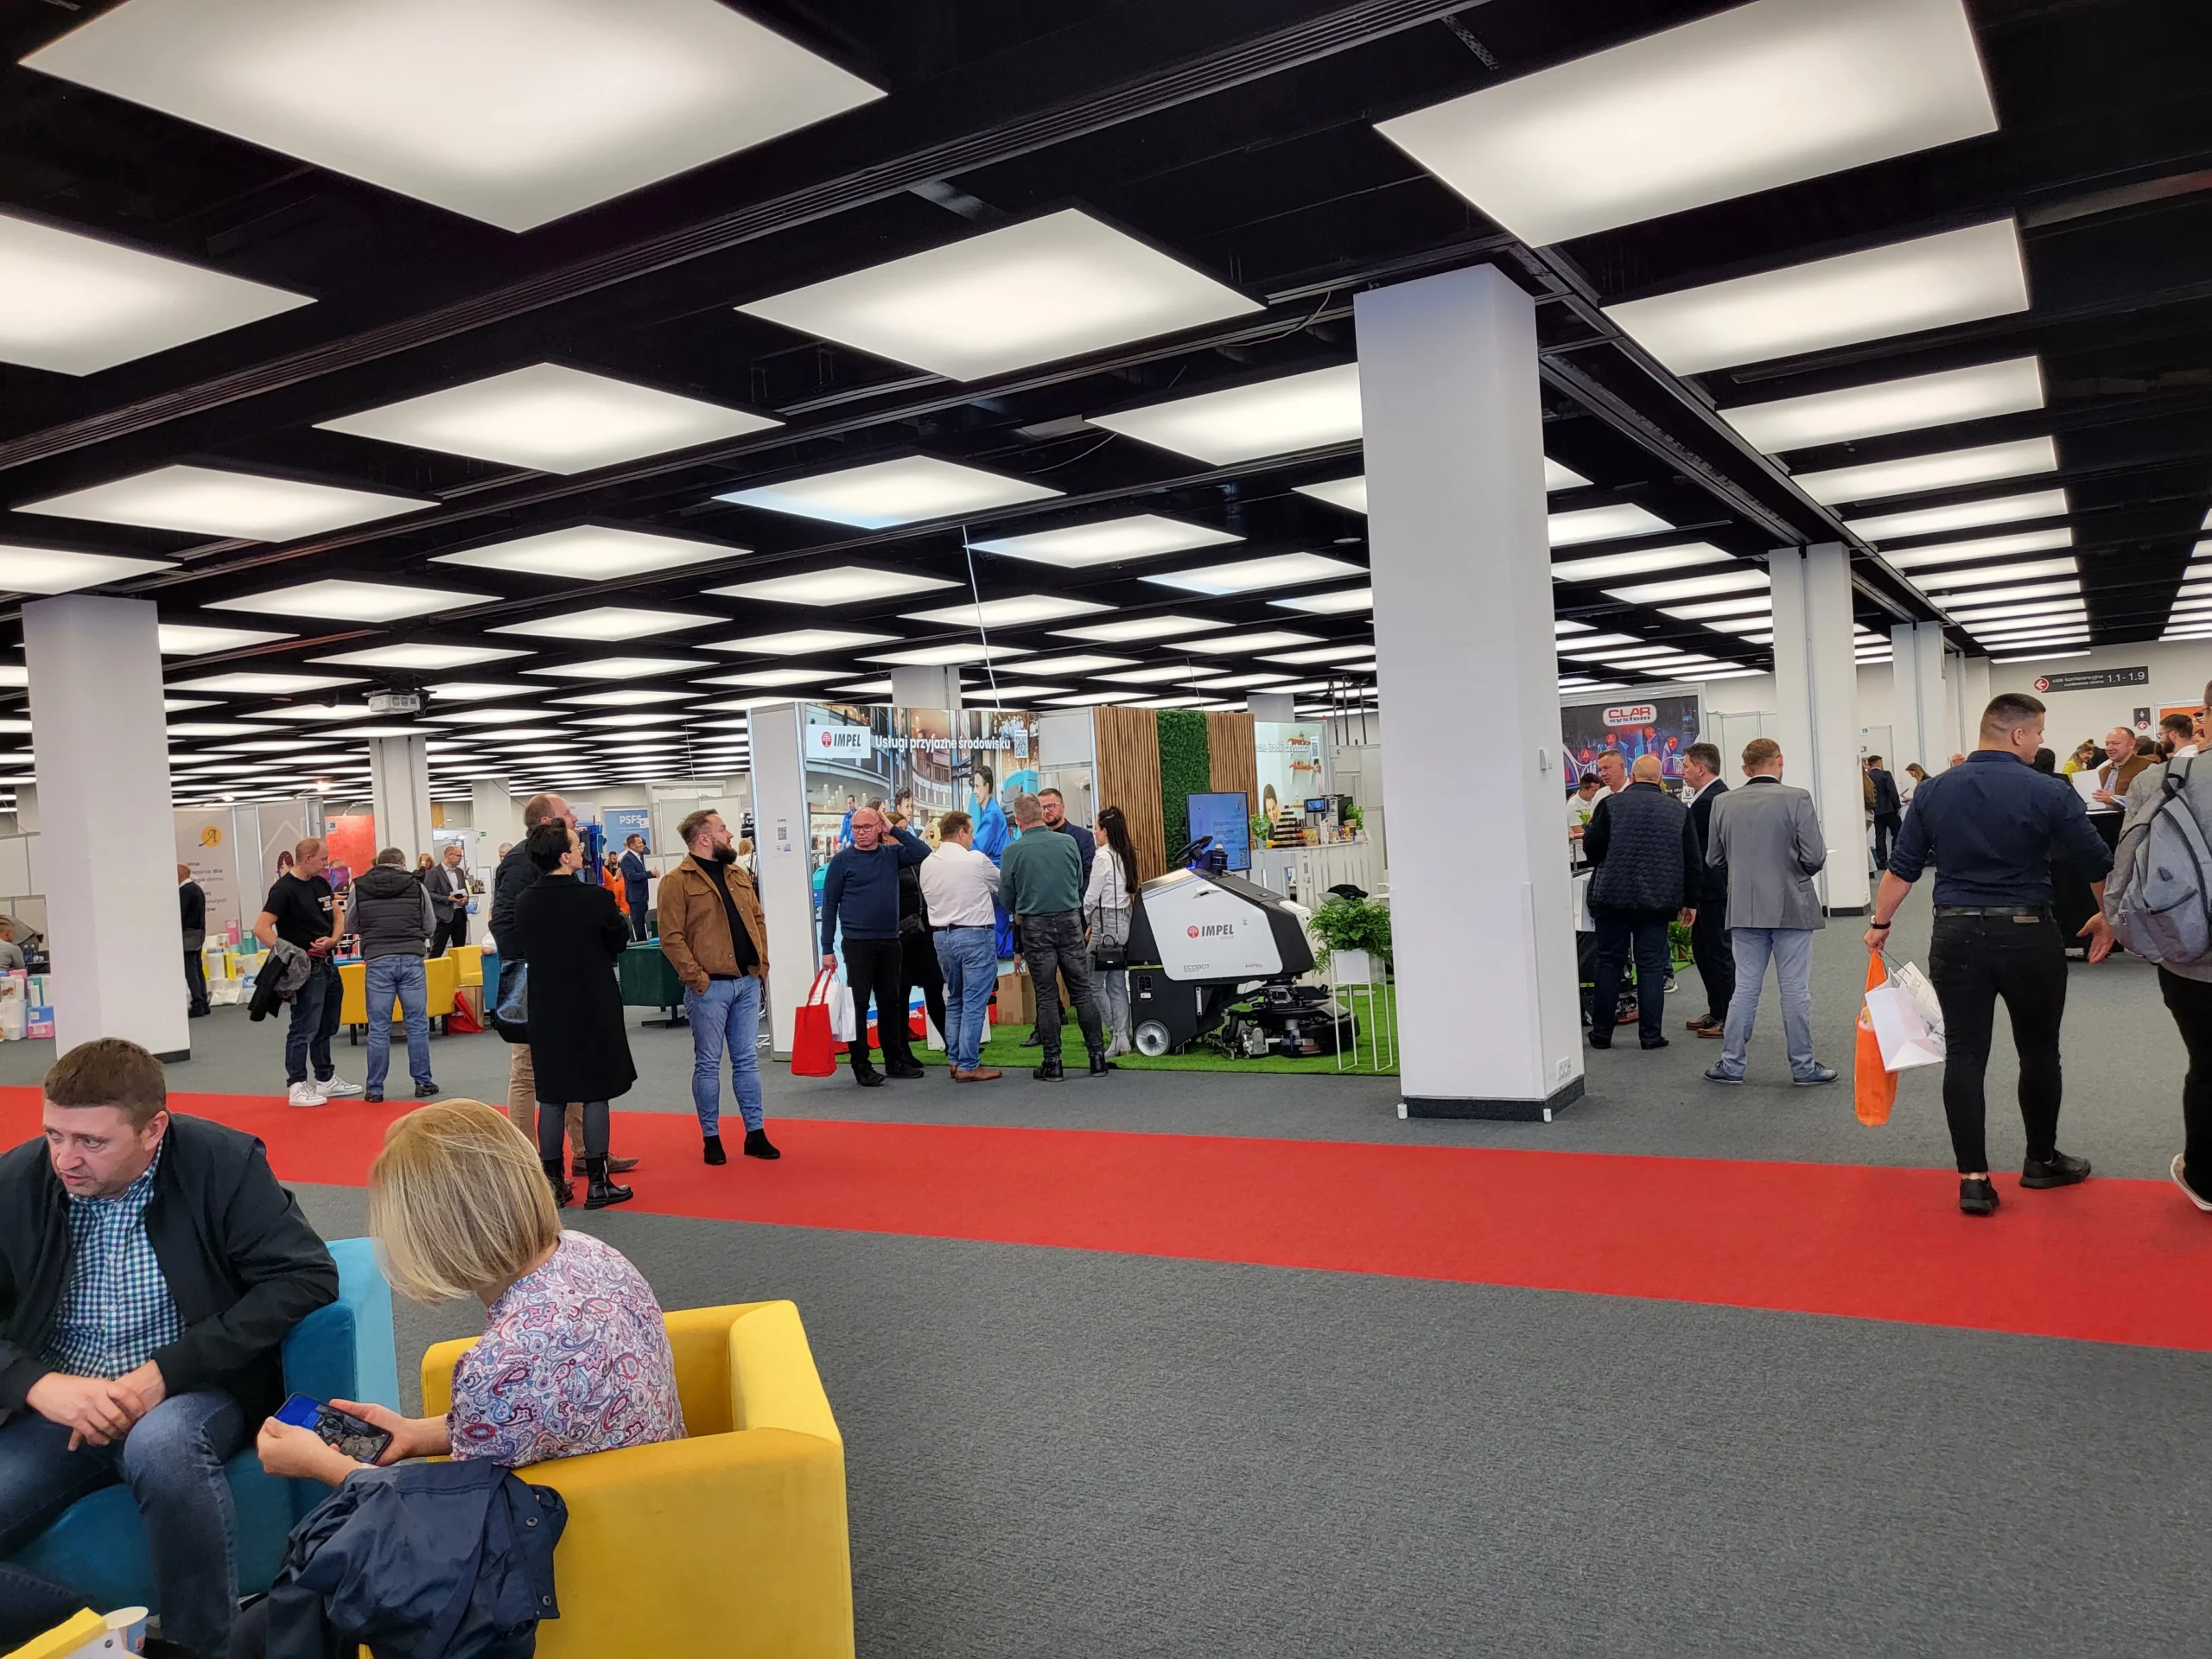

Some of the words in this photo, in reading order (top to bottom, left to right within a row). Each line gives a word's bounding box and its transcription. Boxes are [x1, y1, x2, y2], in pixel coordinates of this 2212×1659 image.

[1608, 707, 1651, 719] CLAR
[834, 734, 861, 747] IMPEL
[875, 734, 908, 753] Usługi
[910, 734, 957, 753] przyjazne
[959, 735, 1011, 750] środowisku
[619, 815, 642, 824] PSFS
[1201, 924, 1234, 937] IMPEL
